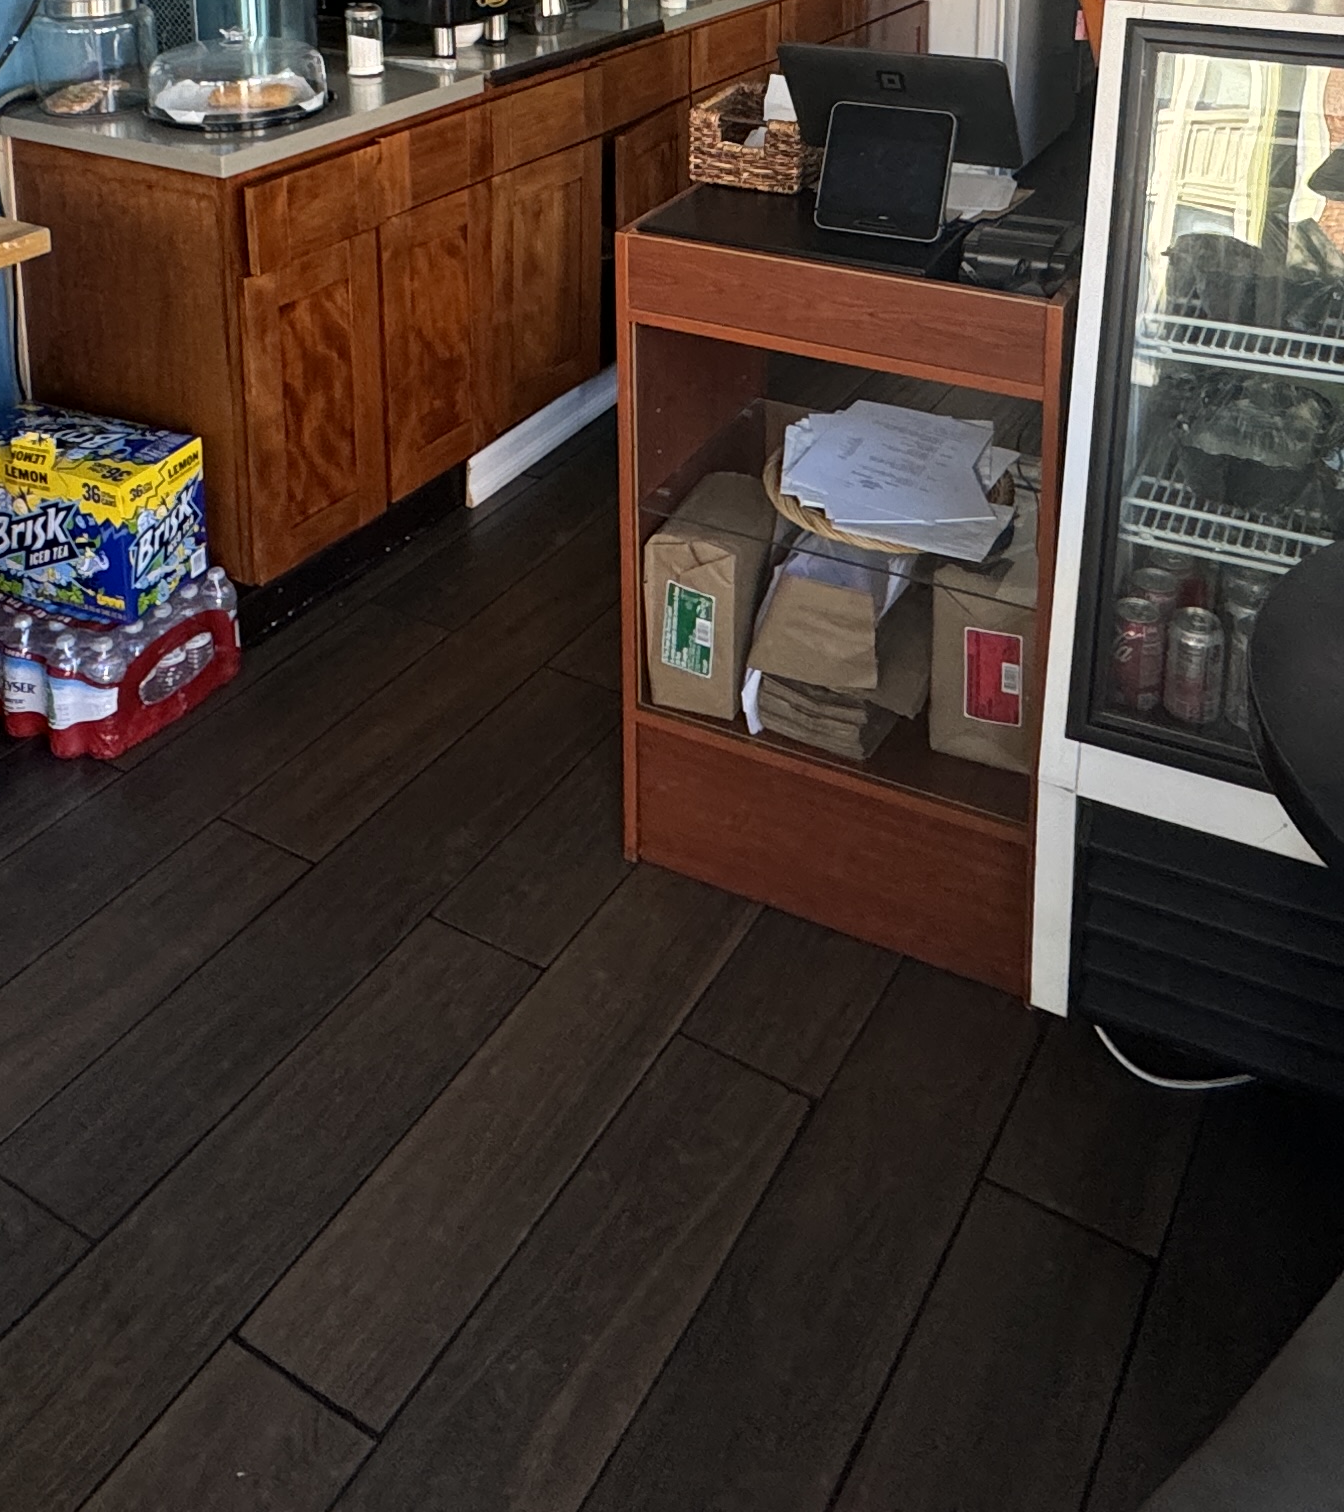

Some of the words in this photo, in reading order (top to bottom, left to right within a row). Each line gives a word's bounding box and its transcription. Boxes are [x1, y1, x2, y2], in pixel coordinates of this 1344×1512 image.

[5, 463, 49, 485] LEMON
[167, 450, 199, 480] LEMON
[81, 482, 102, 504] 36
[129, 483, 143, 502] 36
[136, 484, 194, 579] Brisk
[29, 548, 51, 566] ICED
[52, 544, 70, 562] TEA
